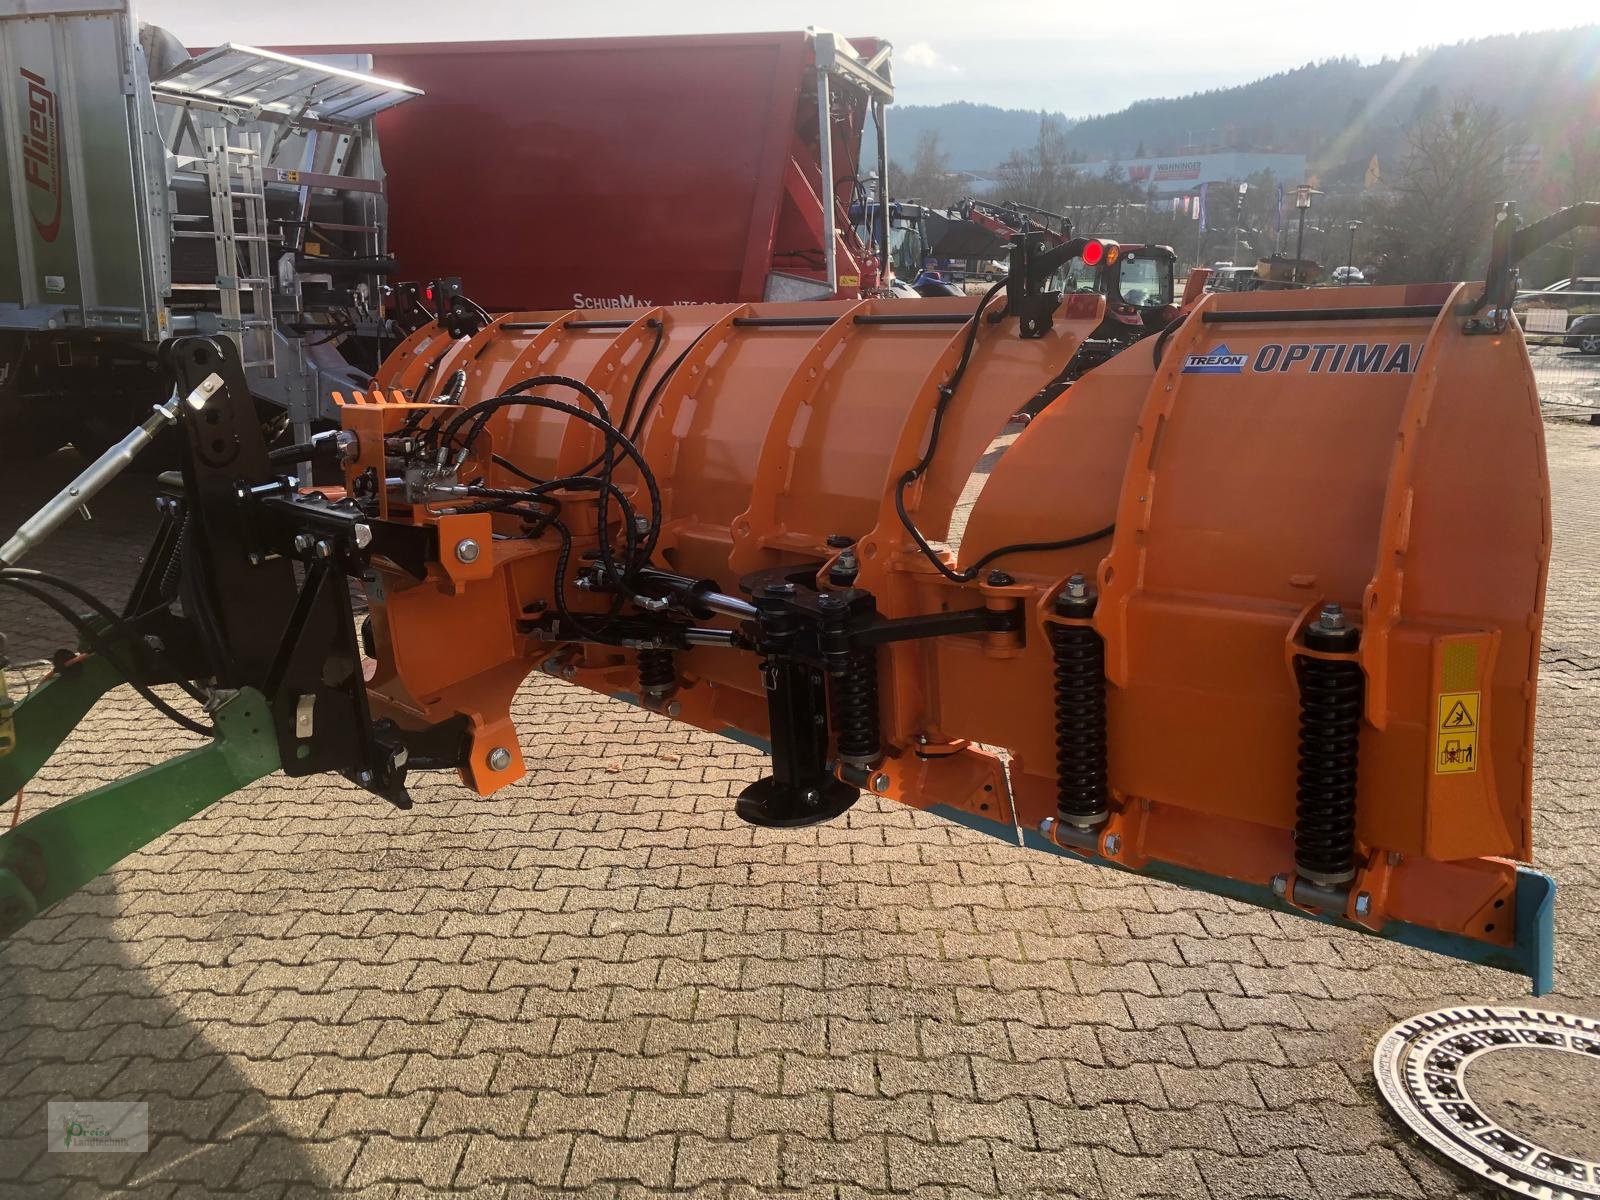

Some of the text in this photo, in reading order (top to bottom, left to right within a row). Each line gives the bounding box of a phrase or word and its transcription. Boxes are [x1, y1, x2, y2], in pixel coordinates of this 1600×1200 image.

[20, 66, 54, 192] Fliegl
[1190, 356, 1243, 365] TREJON
[1252, 343, 1425, 374] OPTIMA
